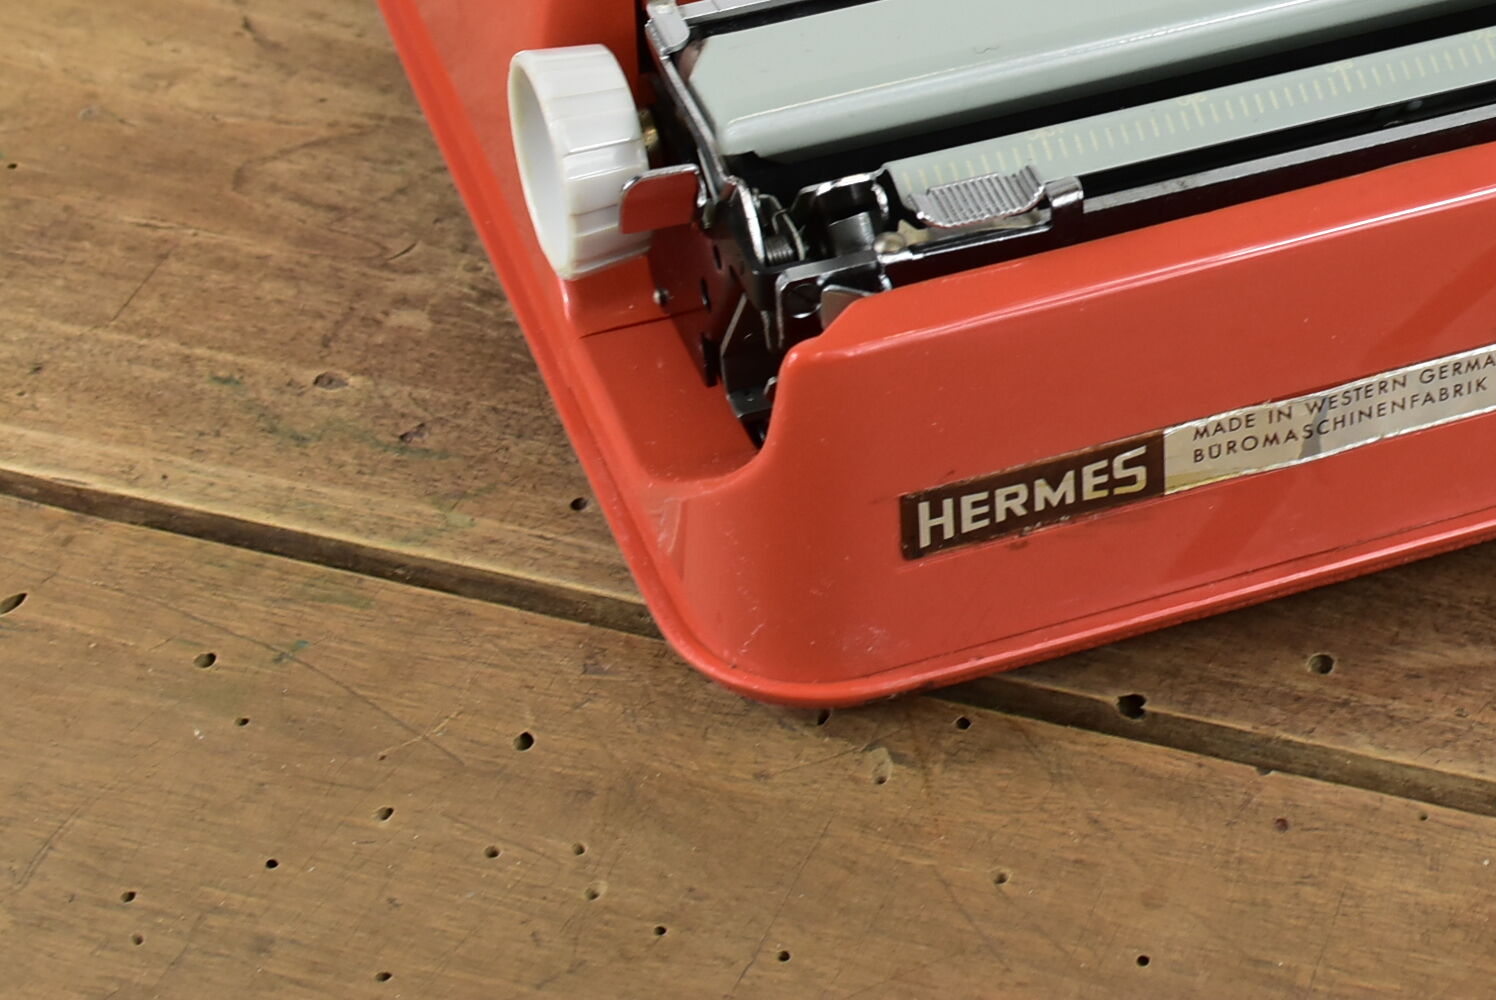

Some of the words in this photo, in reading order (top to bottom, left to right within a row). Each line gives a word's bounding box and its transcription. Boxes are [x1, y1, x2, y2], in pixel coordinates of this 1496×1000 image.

[1192, 412, 1256, 442] MADE
[1268, 404, 1294, 425] IN
[1304, 375, 1408, 415] WESTERN
[1192, 375, 1490, 464] BÜROMASCHINENFABRIK
[917, 445, 1148, 550] HERMES
